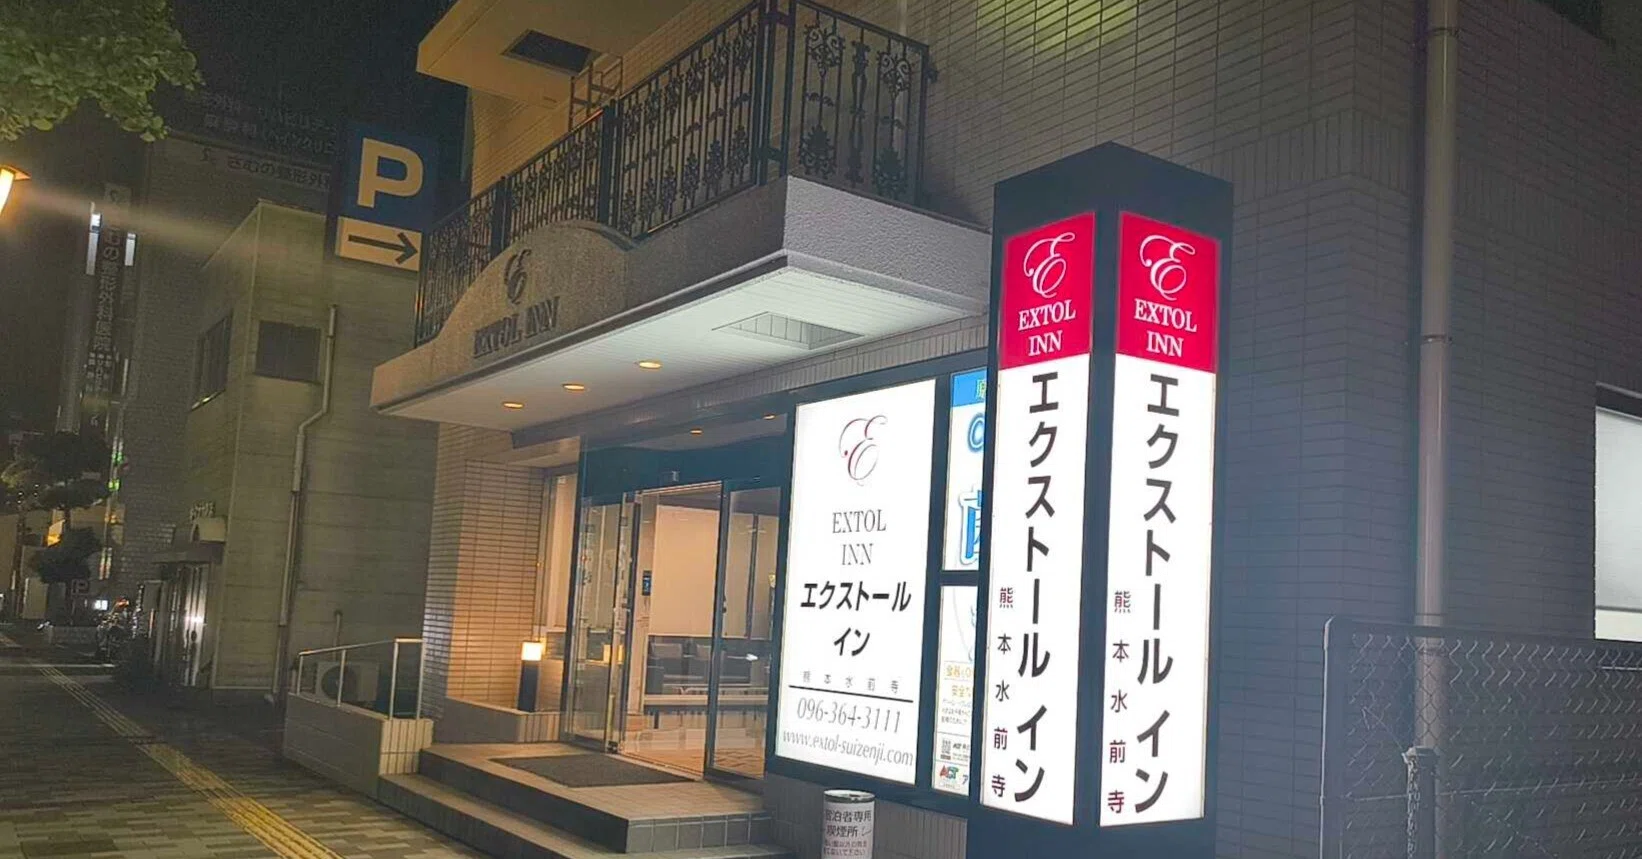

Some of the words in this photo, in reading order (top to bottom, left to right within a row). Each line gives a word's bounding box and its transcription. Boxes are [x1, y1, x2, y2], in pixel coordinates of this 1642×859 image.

[357, 137, 424, 208] P
[473, 313, 522, 358] EXTOL
[524, 295, 561, 339] INN
[1018, 299, 1076, 331] EXTOL
[1134, 298, 1198, 333] EXTOL
[1028, 330, 1063, 357] INN
[1146, 330, 1184, 358] INN
[832, 509, 887, 534] EXTOL
[1017, 372, 1059, 677] エクストール
[1137, 373, 1180, 685] エクストール
[841, 543, 874, 566] INN
[800, 580, 912, 612] エクストール
[834, 627, 870, 657] イン
[991, 587, 1014, 798] 熊本水前寺
[1107, 590, 1131, 814] 熊本水前寺
[797, 697, 900, 733] 096-364-3111
[783, 730, 914, 766] www.extol-suizenji.com
[1014, 704, 1048, 803] イン
[1134, 709, 1170, 814] イン
